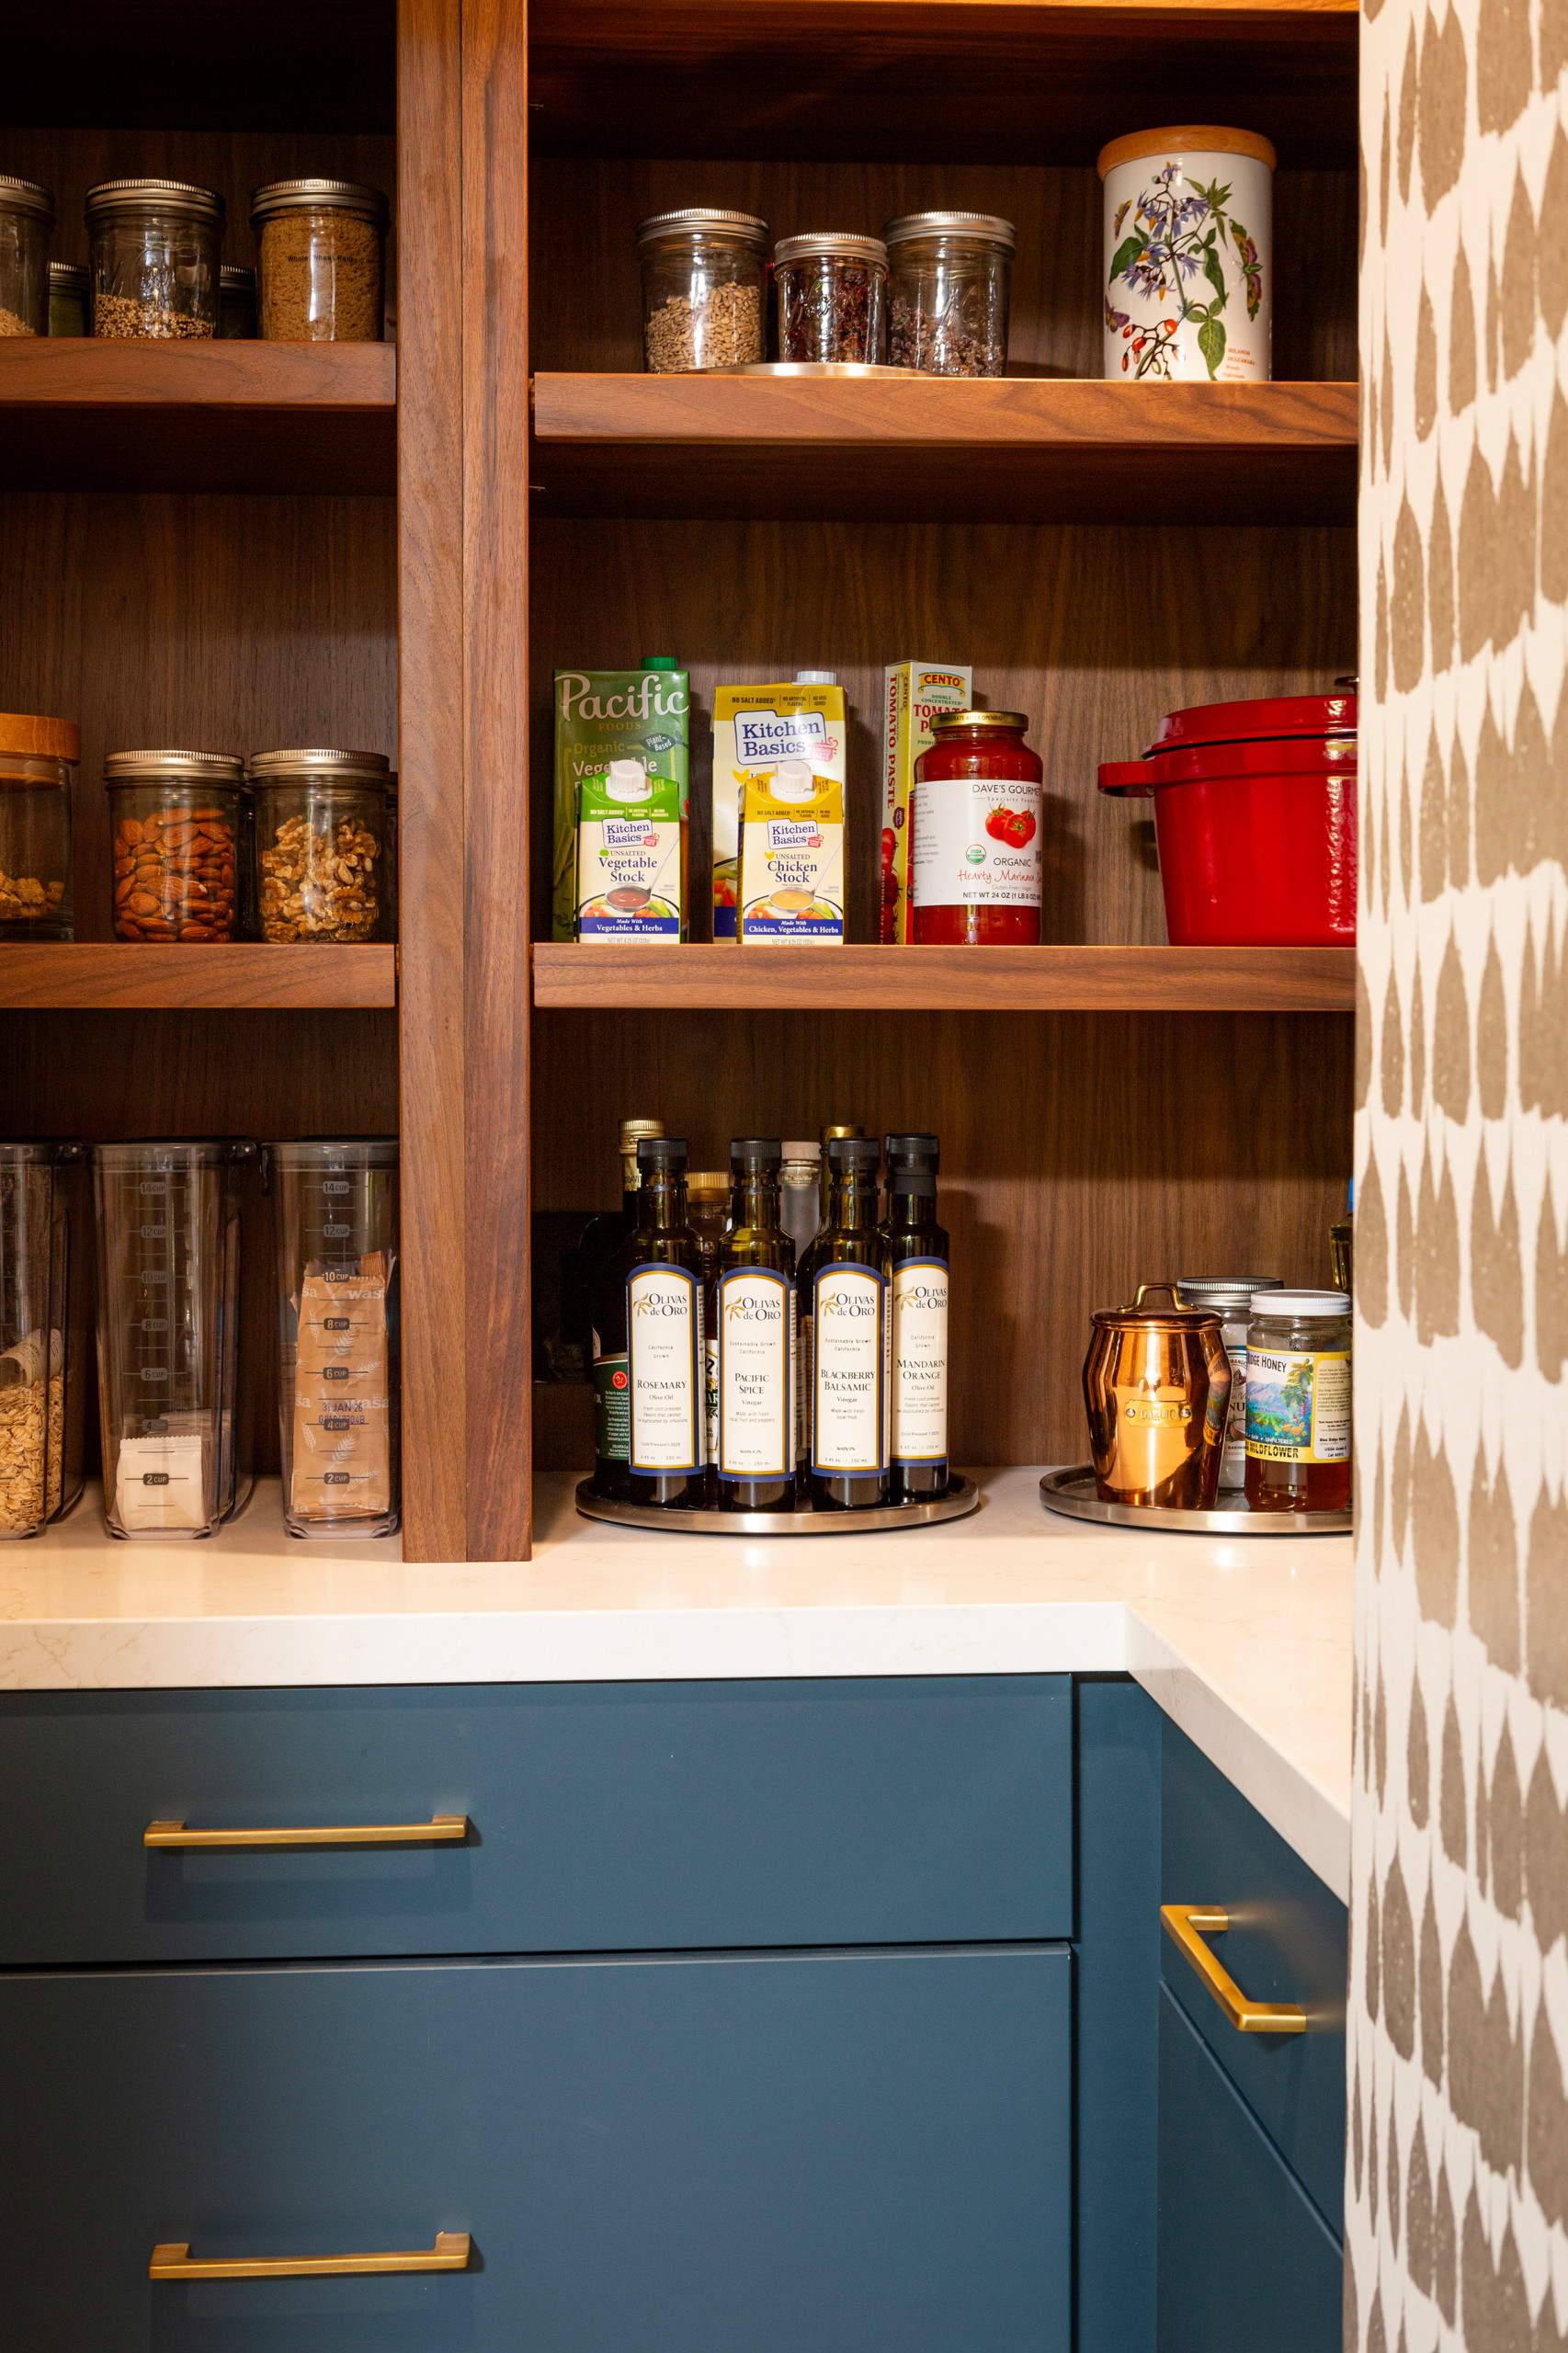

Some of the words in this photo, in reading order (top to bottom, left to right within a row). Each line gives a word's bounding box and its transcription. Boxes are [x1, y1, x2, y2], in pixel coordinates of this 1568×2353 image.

[924, 674, 961, 688] CENTO
[554, 674, 689, 721] Pacific
[888, 673, 898, 749] TOMATO
[598, 721, 642, 732] FOODS
[742, 721, 821, 739] Kitchen
[574, 741, 625, 757] Organic
[654, 741, 672, 752] Based
[744, 739, 806, 756] Basics
[573, 756, 658, 777] Vegele
[887, 754, 896, 809] PASTE
[972, 784, 1006, 794] DAVE'S
[607, 824, 650, 835] Kitchen
[772, 824, 815, 835] Kitchen
[608, 834, 642, 844] Basics
[772, 835, 807, 845] Basics
[598, 857, 658, 870] Vegetable
[767, 860, 817, 871] Chicken
[993, 858, 1031, 867] ORGANIC
[610, 870, 645, 882] Stock
[775, 871, 810, 882] Stock
[958, 870, 992, 884] Hearty
[994, 870, 1035, 882] Marinara
[597, 924, 632, 932] Vegetables
[749, 926, 777, 934] Chicken,
[778, 926, 812, 934] Vegetables
[324, 1183, 335, 1193] 14
[325, 1226, 335, 1236] 12
[324, 1272, 335, 1282] 10
[915, 1287, 947, 1298] OLIVAS
[649, 1293, 687, 1305] OLIVAS
[743, 1297, 780, 1309] OLIVAS
[836, 1293, 874, 1305] OLIVAS
[915, 1301, 926, 1309] de
[927, 1298, 947, 1309] ORO
[650, 1307, 660, 1315] de
[662, 1304, 687, 1316] ORO
[744, 1312, 754, 1320] de
[756, 1309, 780, 1321] ORO
[837, 1308, 847, 1316] de
[849, 1305, 875, 1317] ORO
[145, 1321, 152, 1330] 8
[327, 1320, 334, 1329] 8
[896, 1359, 945, 1369] MANDARIN
[1262, 1356, 1287, 1372] HONEY
[145, 1370, 151, 1379] 6
[326, 1369, 333, 1378] 6
[735, 1373, 769, 1382] PACIFIC
[821, 1370, 875, 1380] BLACKBERRY
[903, 1370, 941, 1380] ORANGE
[637, 1380, 687, 1389] ROSEMARY
[739, 1385, 765, 1394] SPICE
[824, 1381, 871, 1392] BALSAMIC
[323, 1403, 331, 1412] 31
[332, 1403, 352, 1412] JAN
[354, 1403, 363, 1412] 26
[1141, 1409, 1176, 1421] GARLIC
[146, 1421, 152, 1430] 4
[327, 1420, 334, 1429] 4
[1265, 1437, 1293, 1445] UNFILTERED
[1250, 1441, 1299, 1459] WILDFLOWER
[146, 1475, 153, 1484] 2
[327, 1474, 334, 1483] 2
